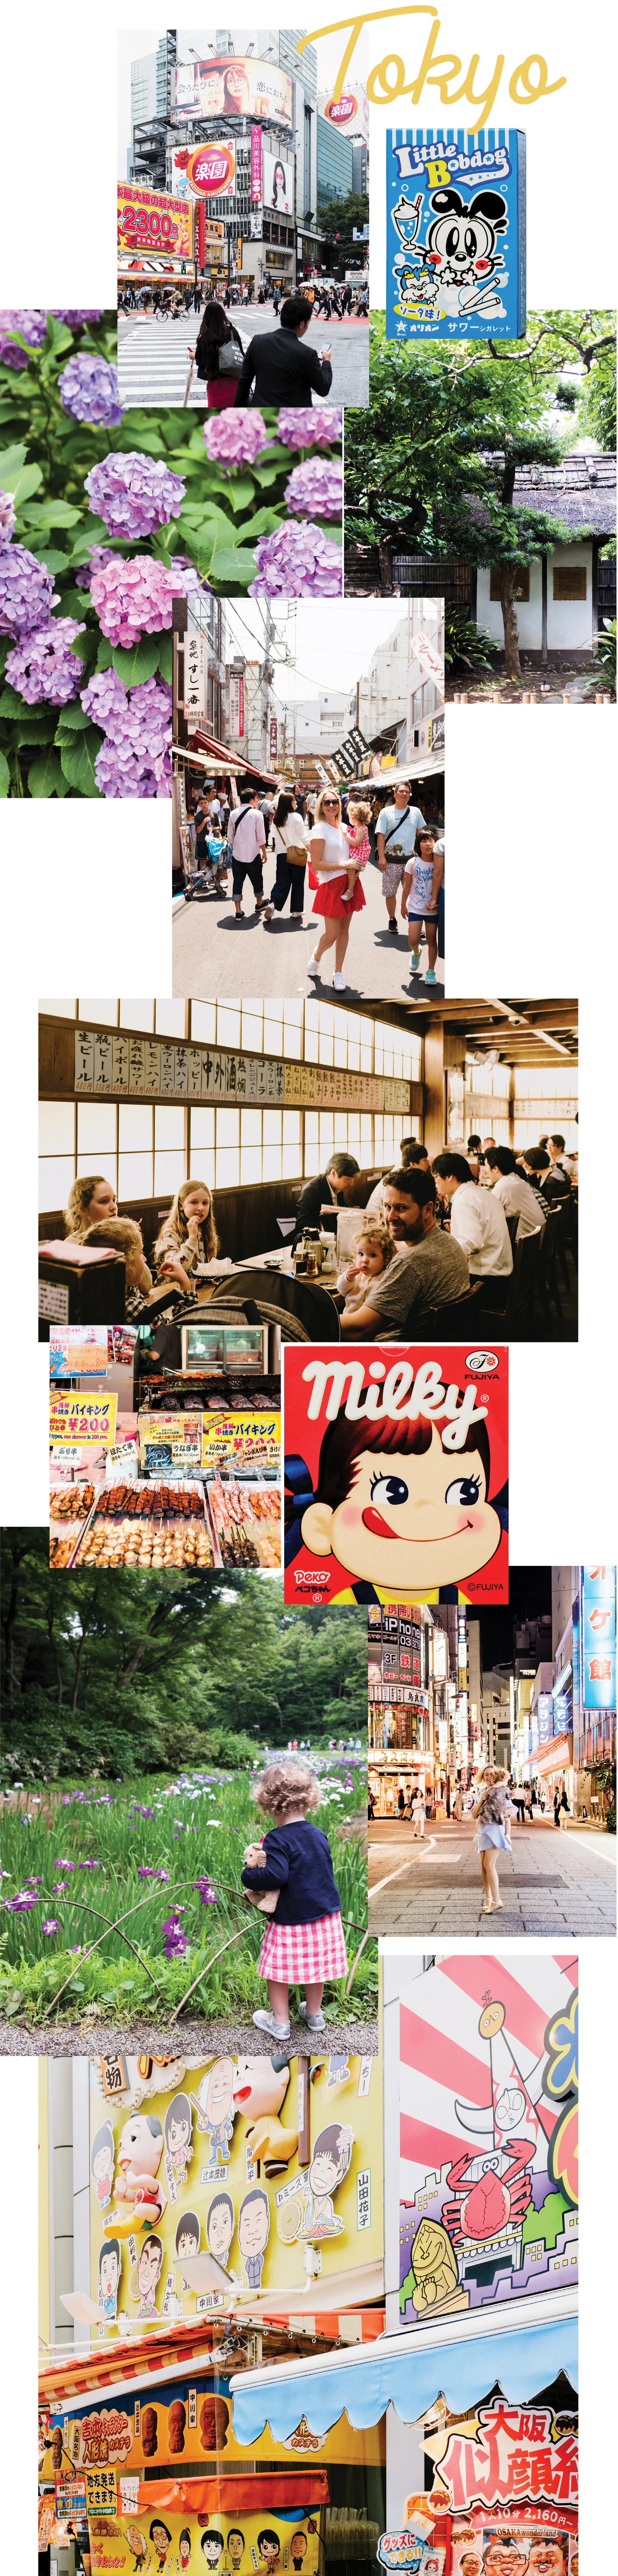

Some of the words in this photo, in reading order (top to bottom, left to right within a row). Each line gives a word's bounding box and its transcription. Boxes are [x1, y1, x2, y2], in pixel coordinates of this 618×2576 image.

[177, 80, 219, 94] 会うたびに、
[256, 81, 290, 105] 恋におちる。
[330, 102, 353, 117] 楽園
[339, 111, 356, 126] AMUSEMENT
[395, 142, 456, 178] Little
[194, 161, 228, 181] 楽園
[425, 147, 510, 189] Bobdog
[189, 180, 205, 197] EXCITING
[207, 176, 233, 197] AMUSEMENT
[137, 237, 165, 247] 渋谷地区合計
[447, 322, 479, 332] サワー
[414, 867, 434, 876] Bright
[414, 884, 426, 899] Finely
[76, 1031, 93, 1082] 生ビール
[95, 1034, 111, 1083] 瓶ビール
[114, 1037, 128, 1085] ハイボール
[146, 1042, 159, 1086] レモンハイ
[175, 1047, 187, 1089] 抹茶ハイ
[189, 1049, 200, 1090] ホッピー
[202, 1052, 213, 1090] 中
[214, 1054, 224, 1092] 外
[226, 1055, 236, 1092] 酒
[257, 1060, 266, 1095] コーラ
[76, 1081, 92, 1091] 480円
[94, 1083, 110, 1093] 550円
[112, 1085, 128, 1093] 400円
[129, 1086, 144, 1094] 400円
[145, 1087, 159, 1095] 400円
[174, 1089, 186, 1097] 400円
[95, 1358, 107, 1367] 800
[50, 1393, 62, 1404] 名物
[71, 1403, 110, 1415] バイキング
[68, 1417, 110, 1432] ¥200
[235, 1423, 276, 1436] バイキング
[58, 1447, 77, 1455] ぶり串
[110, 1442, 133, 1456] ほたて串
[173, 1444, 198, 1452] うなぎ串
[385, 1617, 420, 1639] iPhone
[384, 1653, 397, 1664] 3F
[407, 1692, 425, 1704] 鳥良商
[539, 1698, 549, 1743] アラジン
[203, 2167, 226, 2181] 辻本茂雄
[166, 2164, 177, 2202] 知やすえ
[358, 2174, 369, 2226] 山田花子
[199, 2296, 219, 2309] 中川家
[81, 2417, 102, 2441] 吉本
[102, 2415, 128, 2437] キャラクター
[484, 2404, 546, 2443] 大阪
[82, 2437, 109, 2464] 人形焼
[109, 2435, 131, 2452] カステラ
[291, 2438, 319, 2449] カステラ
[86, 2472, 115, 2488] 地方発送
[88, 2490, 116, 2504] できます。
[199, 2515, 207, 2524] 大入
[497, 2526, 558, 2538] OSAKAwonderland
[383, 2534, 416, 2548] グッズに
